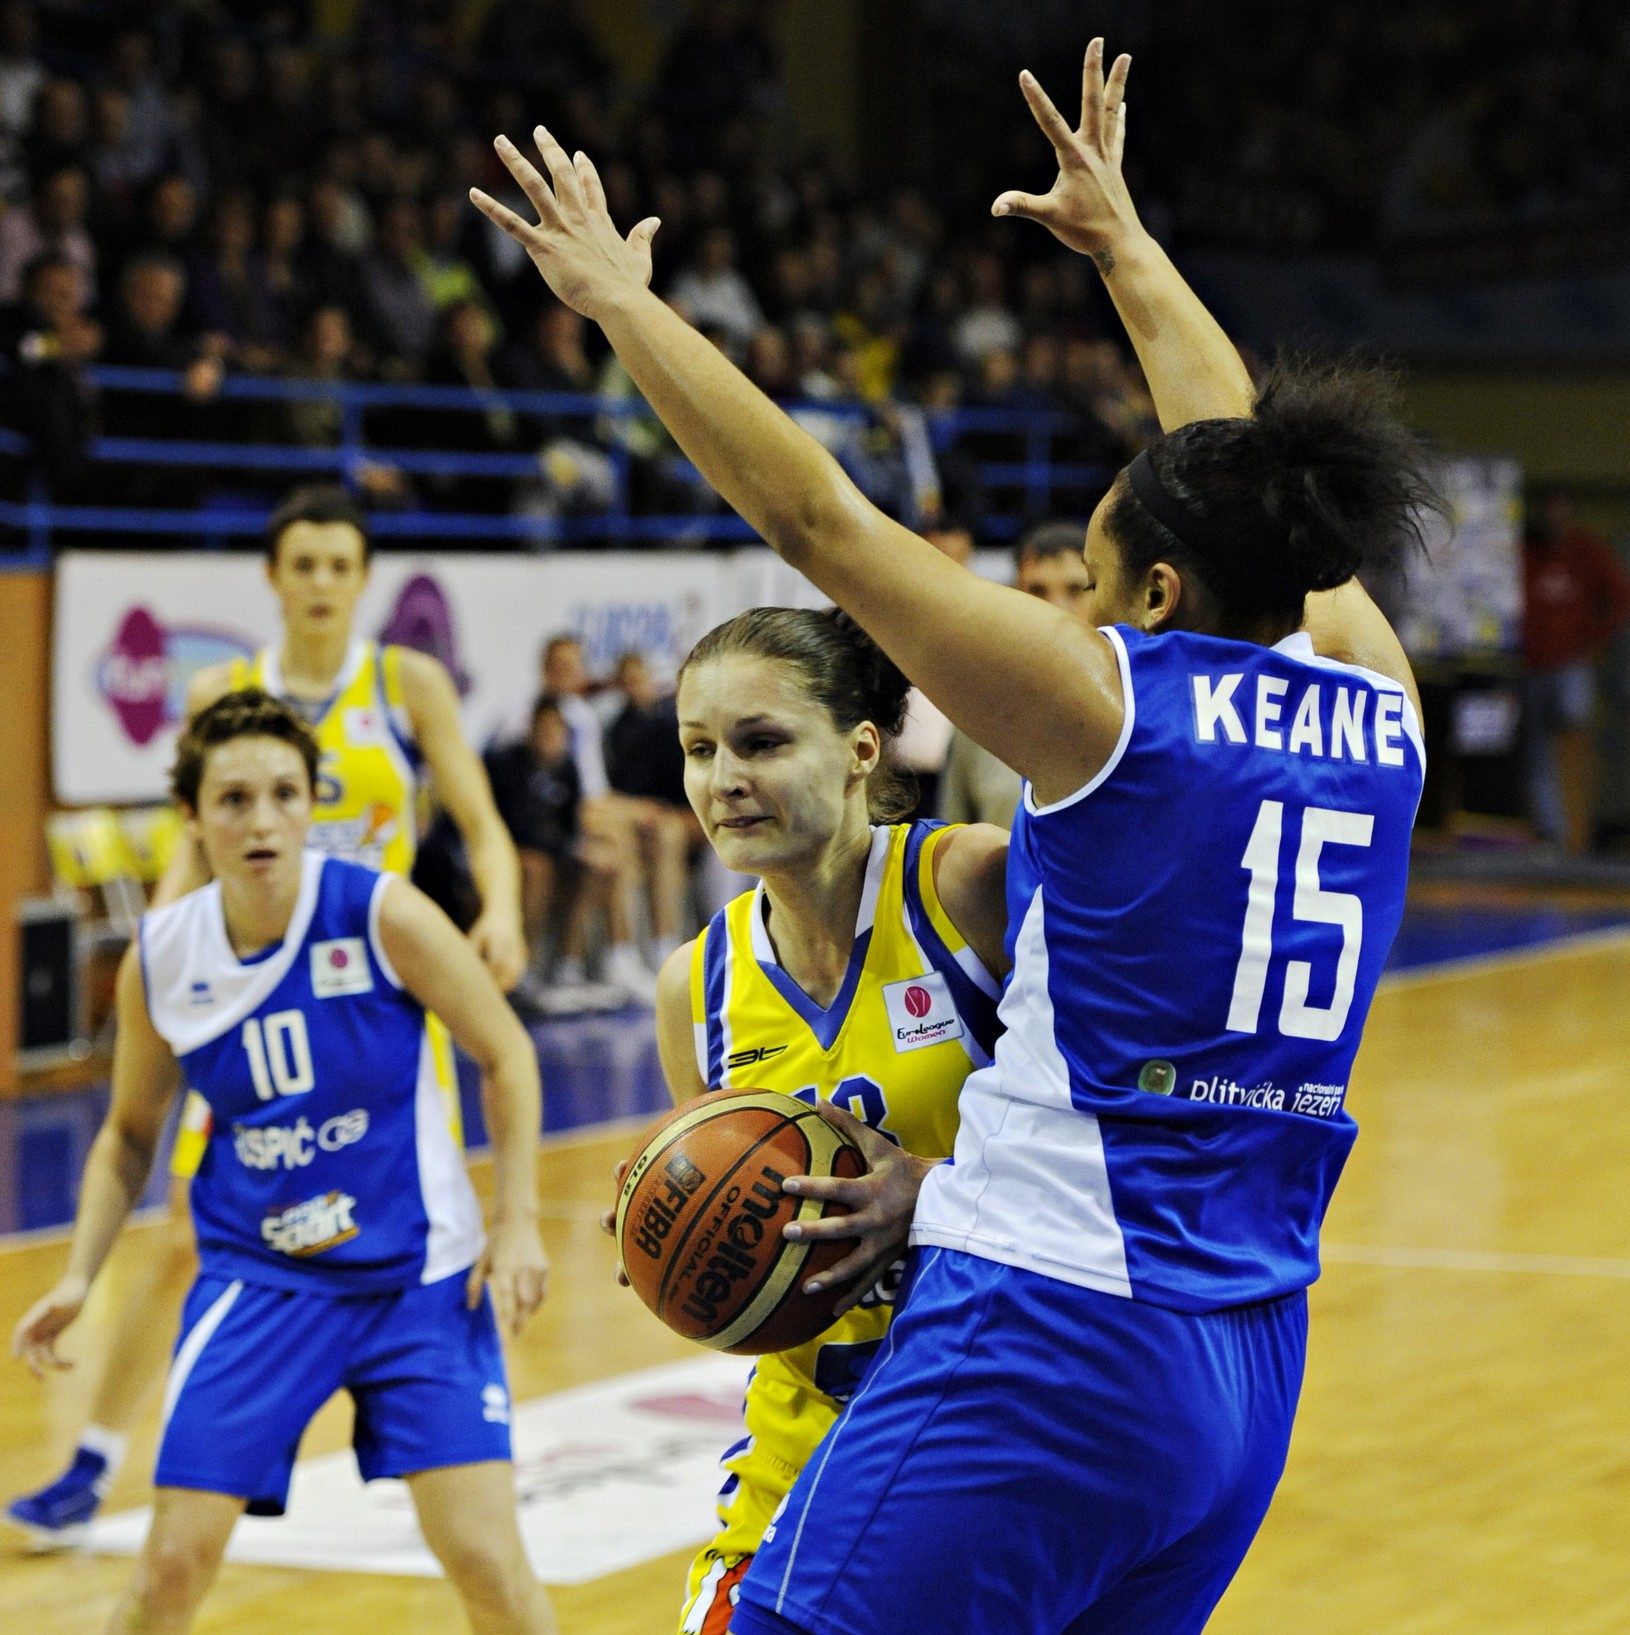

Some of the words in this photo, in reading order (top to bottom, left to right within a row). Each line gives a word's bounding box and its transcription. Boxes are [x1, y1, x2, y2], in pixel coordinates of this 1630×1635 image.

[1192, 672, 1404, 767] KEANE
[1226, 799, 1375, 1042] 15
[241, 1008, 315, 1101] 10
[907, 1029, 946, 1043] Women
[635, 1178, 690, 1260] FIBA
[680, 1186, 741, 1281] OFFICIAL
[682, 1165, 791, 1322] molten
